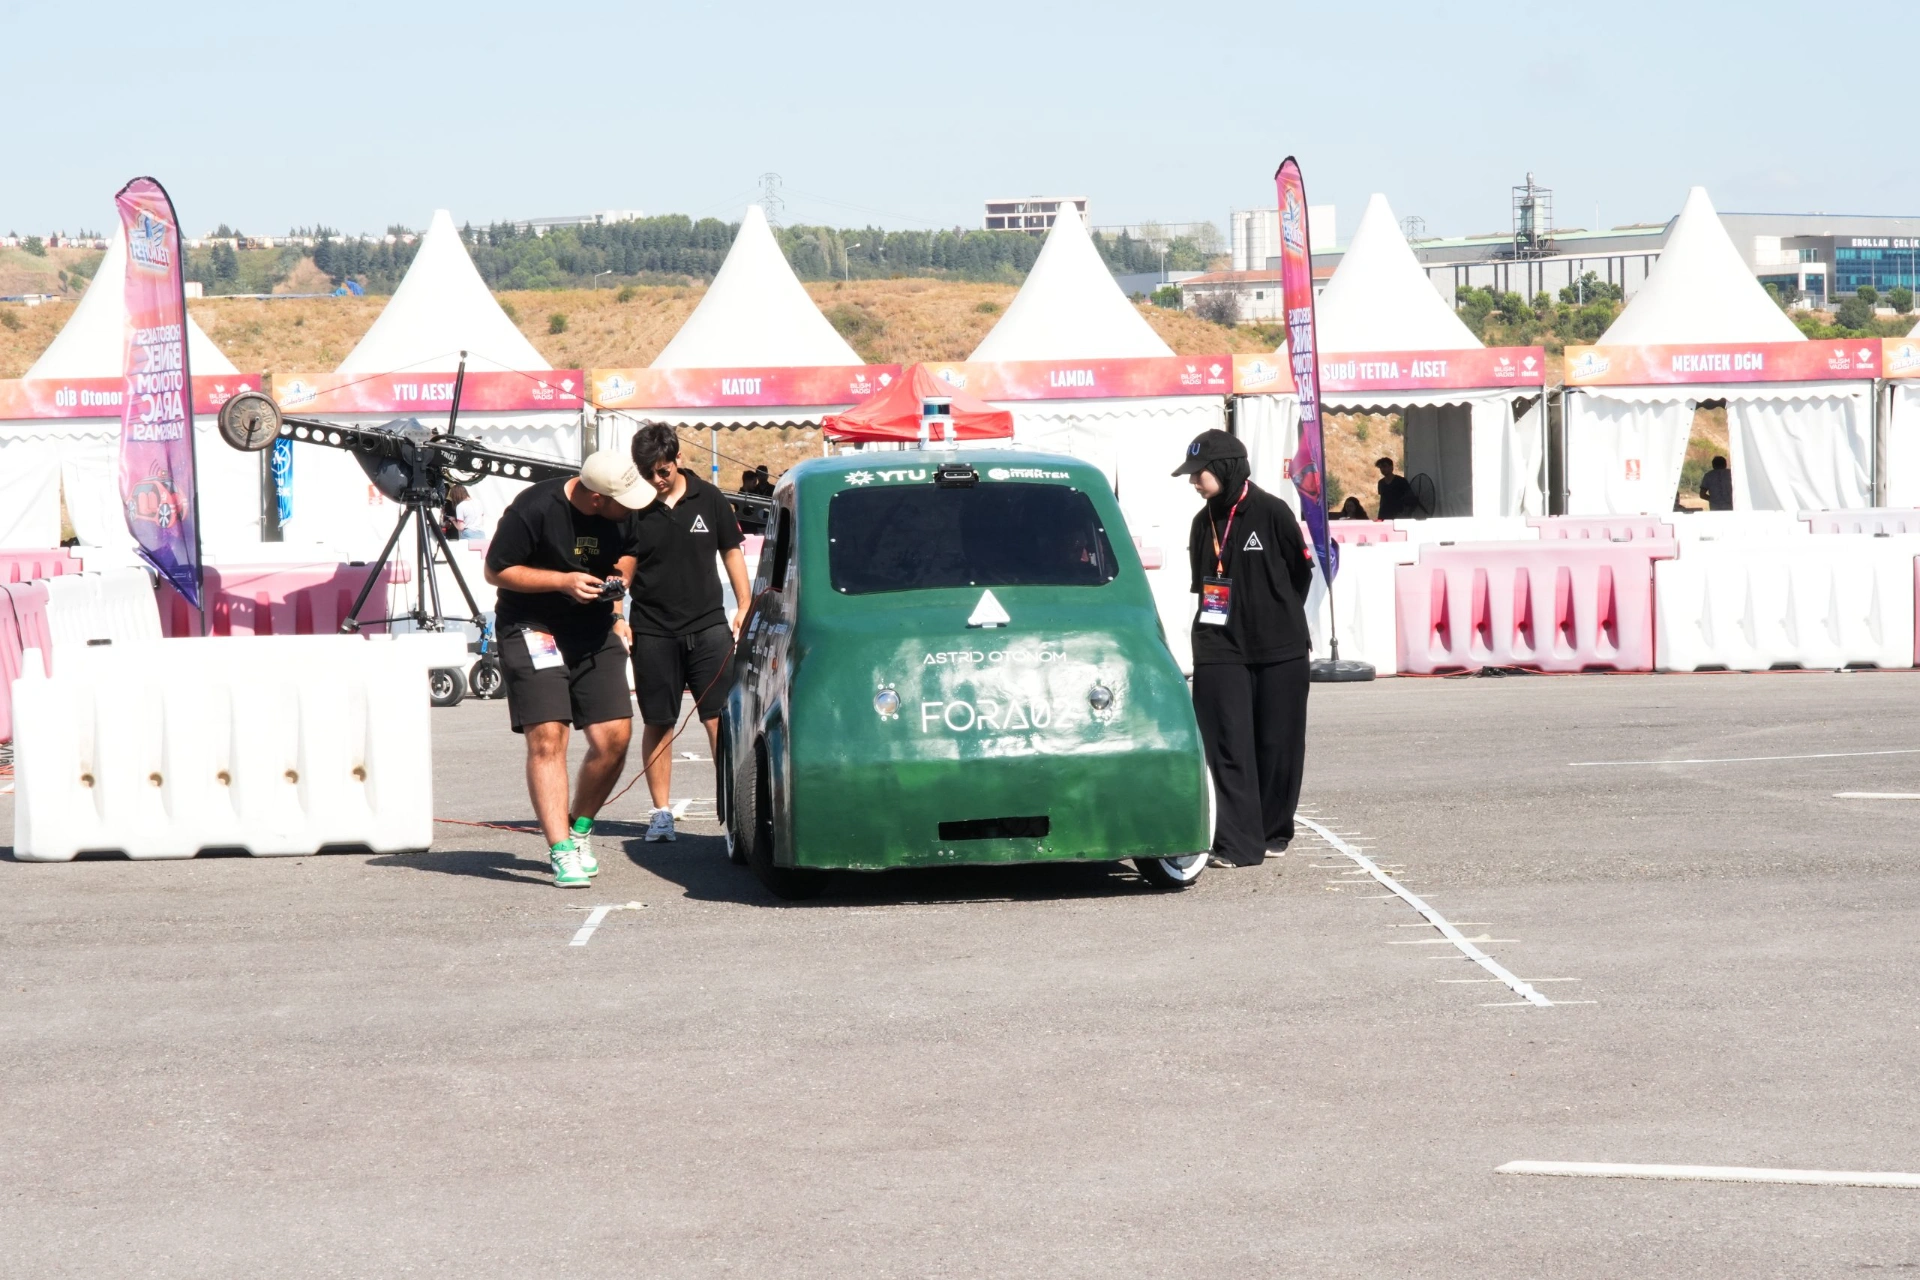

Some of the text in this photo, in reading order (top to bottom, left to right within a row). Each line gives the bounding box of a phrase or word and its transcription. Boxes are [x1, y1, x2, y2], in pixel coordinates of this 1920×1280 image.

[1852, 238, 1889, 247] EROLLAR
[1322, 360, 1356, 380] SUBÜ
[1359, 361, 1400, 380] TETRA
[1410, 359, 1447, 379] AISET
[1672, 353, 1731, 372] MEKATEK
[722, 378, 762, 395] KATOT
[1050, 369, 1095, 387] LAMDA
[55, 386, 78, 407] OİB
[393, 383, 455, 401] YTU AESK
[876, 469, 927, 482] YTU
[988, 651, 1067, 663] OTONOM
